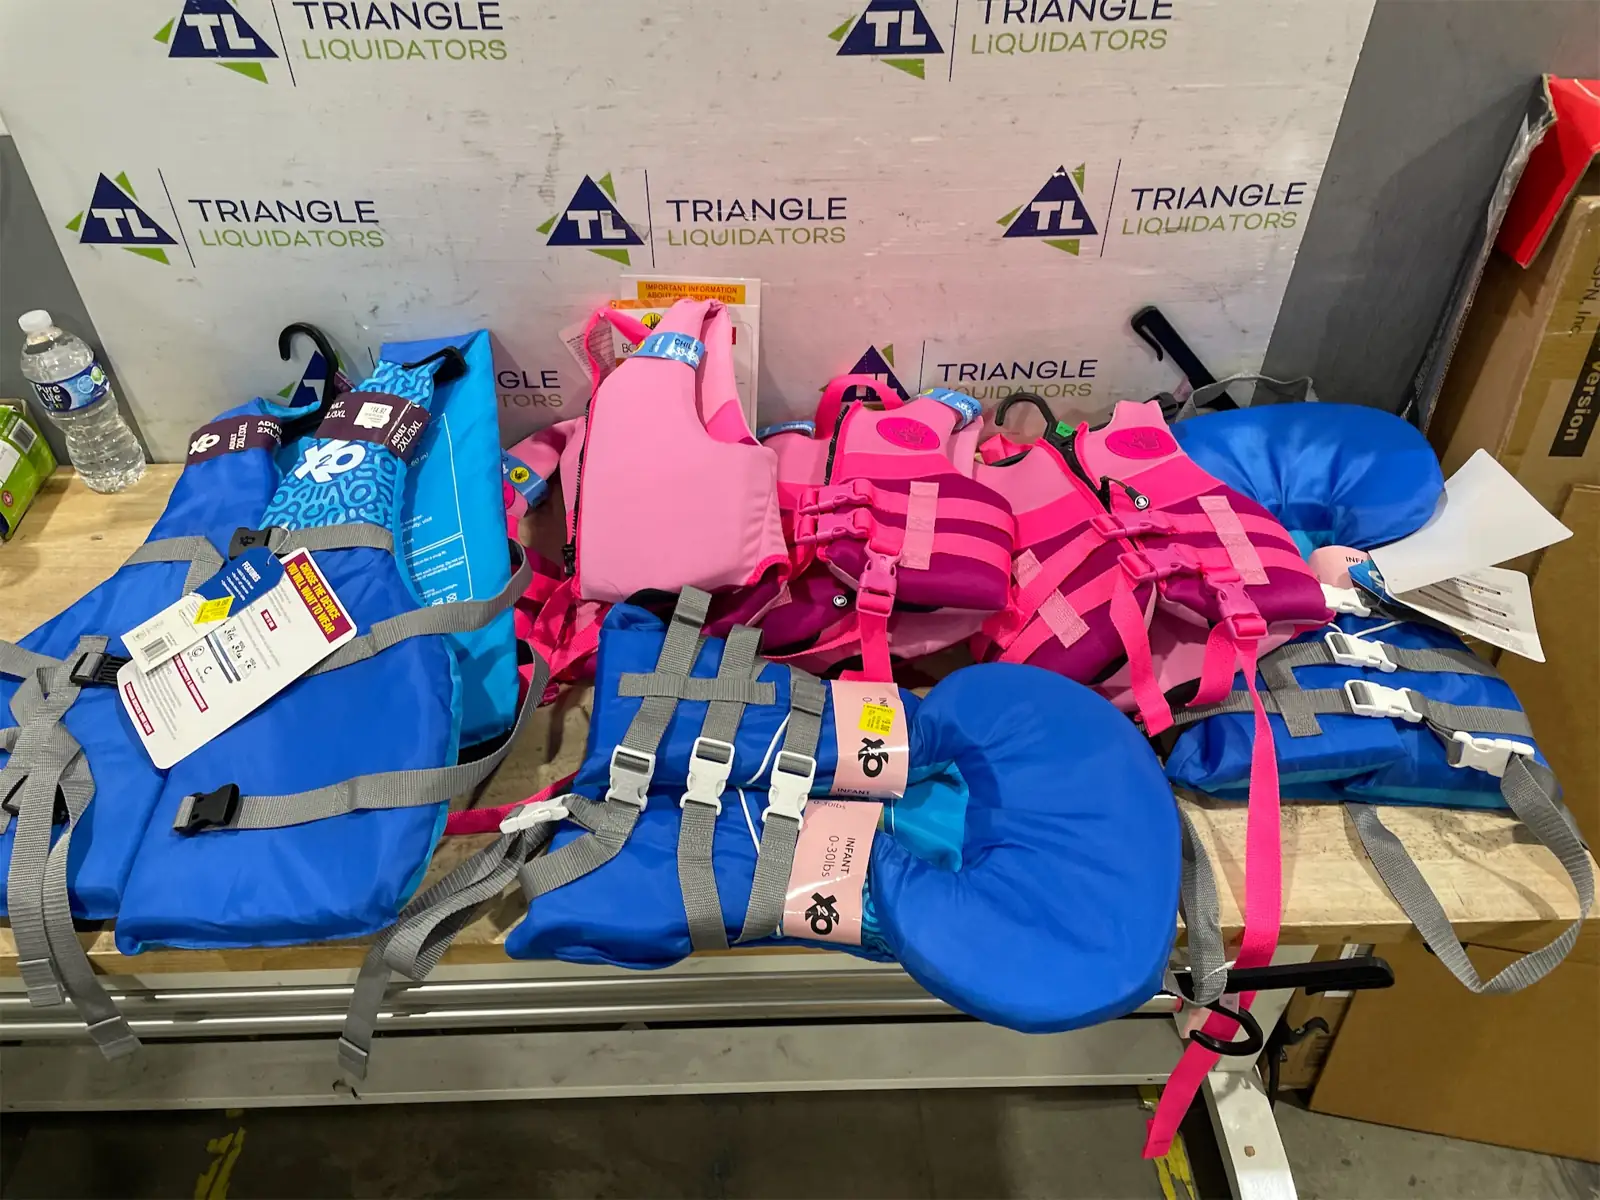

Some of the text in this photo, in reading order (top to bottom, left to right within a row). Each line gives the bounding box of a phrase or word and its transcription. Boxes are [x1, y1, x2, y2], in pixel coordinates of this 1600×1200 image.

[292, 1, 504, 30] TRIANGLE
[183, 13, 256, 50] TL
[866, 10, 927, 48] TL
[302, 38, 507, 62] LIQUIDATORS
[971, 29, 1168, 56] LIQUIDATORS
[1131, 182, 1308, 211] TRIANGLE
[188, 199, 380, 224] TRIANGLE
[666, 197, 848, 222] TRIANGLE
[1031, 200, 1084, 230] TL
[91, 208, 159, 238] TL
[567, 210, 627, 239] TL
[1122, 211, 1298, 235] LIQUIDATORS
[199, 229, 384, 248] LIQUIDATORS
[668, 226, 847, 248] LIQUIDATORS
[645, 283, 738, 294] IMPORTANT INFORMATION
[675, 338, 699, 352] CHILD
[938, 359, 1098, 382] TRIANGLE
[36, 383, 60, 394] Pure
[42, 392, 62, 404] Life
[391, 423, 408, 447] ADULT
[397, 420, 423, 453] 2XL/3XL
[286, 561, 336, 635] YOU WILL WANT TO WEAR
[299, 561, 341, 620] CHOOSE THE DEVICE
[837, 787, 870, 795] INFANT
[840, 837, 856, 875] INFANT
